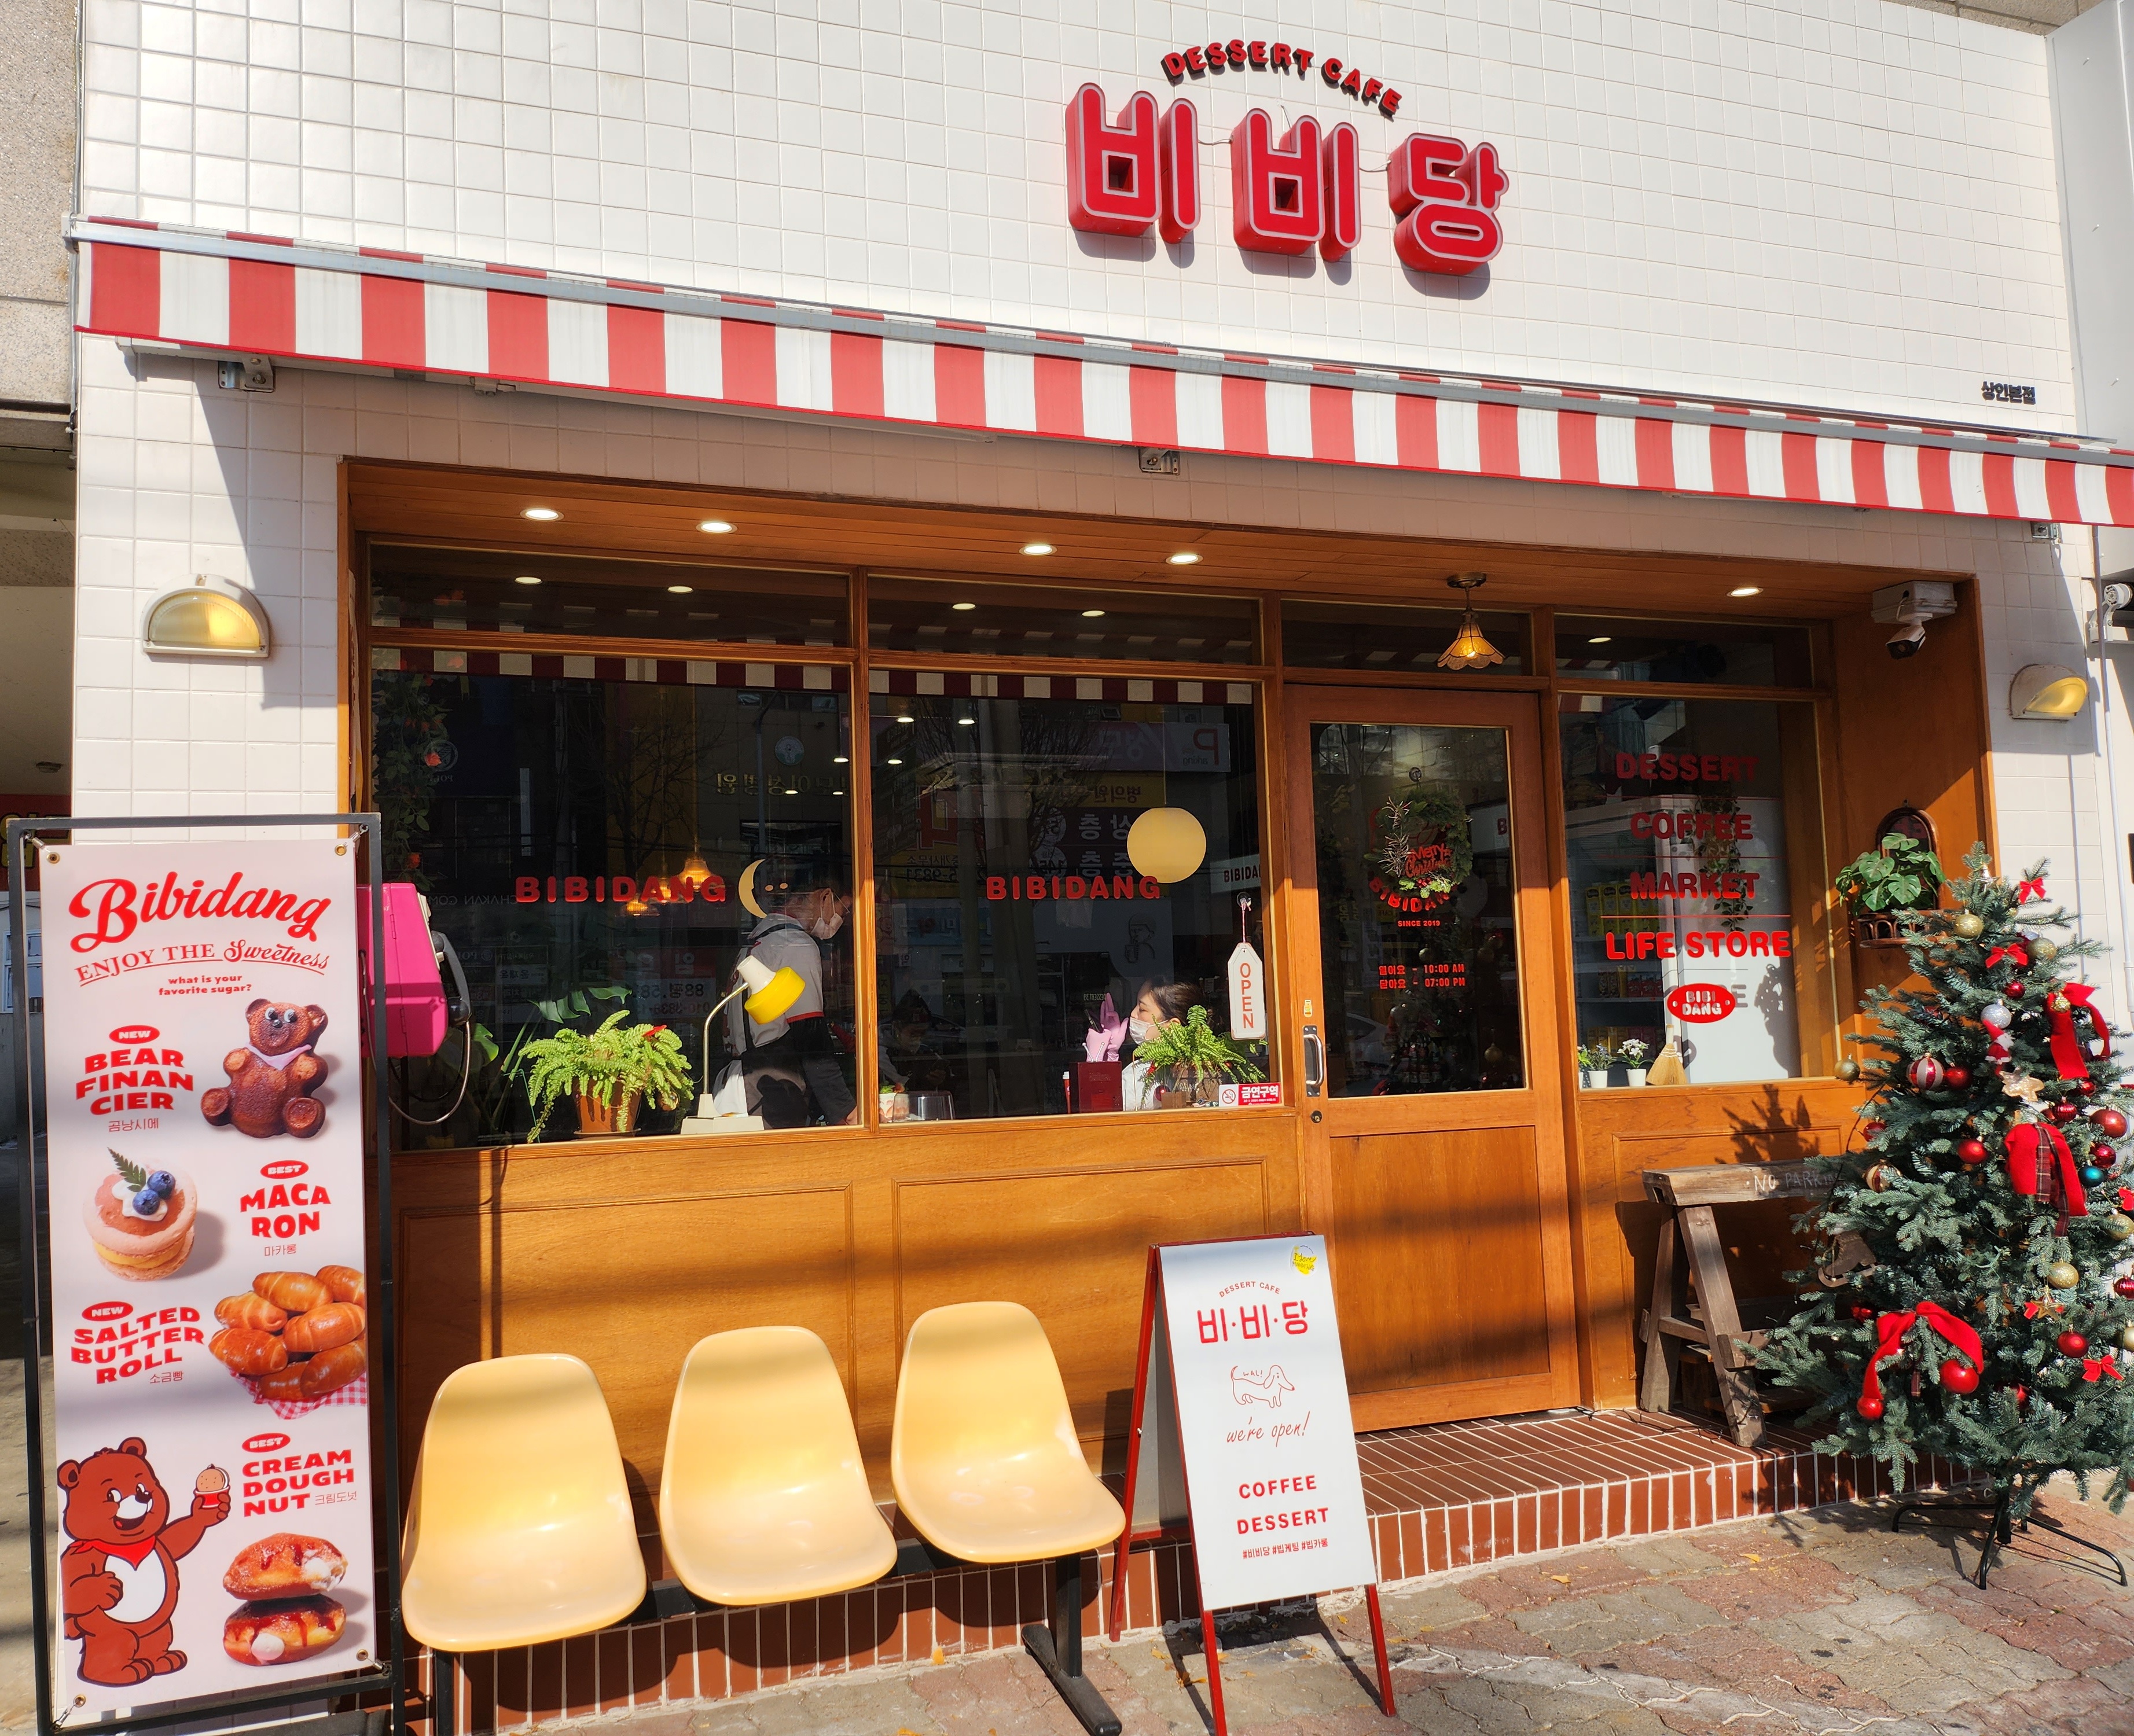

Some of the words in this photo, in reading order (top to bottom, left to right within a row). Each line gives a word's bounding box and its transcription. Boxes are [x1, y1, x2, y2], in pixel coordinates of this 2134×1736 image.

[1161, 39, 1314, 86] DESSERT
[1321, 57, 1403, 120] CAFE
[1066, 82, 1509, 277] 비비당
[1981, 381, 2036, 405] 상인본점
[1615, 752, 1760, 781] DESSERT
[1630, 812, 1753, 840] COFFEE
[1224, 865, 1261, 883] BIBIDA
[1629, 872, 1760, 899] MARKET
[515, 876, 726, 903] BIBIDANG
[986, 876, 1160, 900] BIBIDANG
[68, 871, 332, 952] Bibidang
[1606, 932, 1677, 960] LIFE
[1685, 930, 1791, 958] STORE
[75, 949, 155, 982] ENJOY
[163, 944, 215, 961] THE
[223, 939, 329, 970] Sweetness
[1424, 964, 1449, 973] 10:00
[1452, 963, 1465, 973] AM
[159, 985, 208, 996] favorite
[211, 984, 252, 996] sugar?
[168, 975, 199, 985] what
[201, 975, 211, 984] is
[214, 974, 243, 985] your
[1424, 978, 1450, 987] 07:00
[1453, 977, 1465, 986] PM
[1240, 962, 1254, 1029] OPEN
[1685, 990, 1716, 1003] BIBI
[1682, 1002, 1722, 1016] DANG
[118, 1030, 151, 1039] NEW
[84, 1048, 184, 1075] BEAR
[75, 1070, 194, 1100] FINAN
[1241, 1085, 1279, 1099] 금연구역
[90, 1092, 175, 1116] CIER
[108, 1117, 160, 1132] 곰낭시에
[267, 1164, 302, 1175] BEST
[1754, 1174, 1777, 1191] NO
[240, 1183, 331, 1212] MACA
[251, 1211, 321, 1239] RON
[265, 1244, 297, 1257] 마카롱
[1219, 1281, 1257, 1297] DESSERT
[1259, 1282, 1281, 1295] CAFE
[91, 1306, 124, 1316] NEW
[74, 1307, 200, 1345] SALTED
[71, 1327, 205, 1364] BUTTER
[96, 1348, 183, 1385] ROLL
[149, 1370, 184, 1384] 소금빵
[1271, 1411, 1310, 1448] open!
[249, 1437, 284, 1449] BEST
[242, 1449, 352, 1477] CREAM
[243, 1468, 354, 1498] DOUGH
[1239, 1474, 1317, 1499] COFFEE
[244, 1494, 311, 1517] NUT
[314, 1491, 358, 1506] 크림도넛
[1236, 1507, 1329, 1535] DESSERT
[1243, 1546, 1270, 1560] #비비당
[1301, 1538, 1328, 1550] #빕카롱
